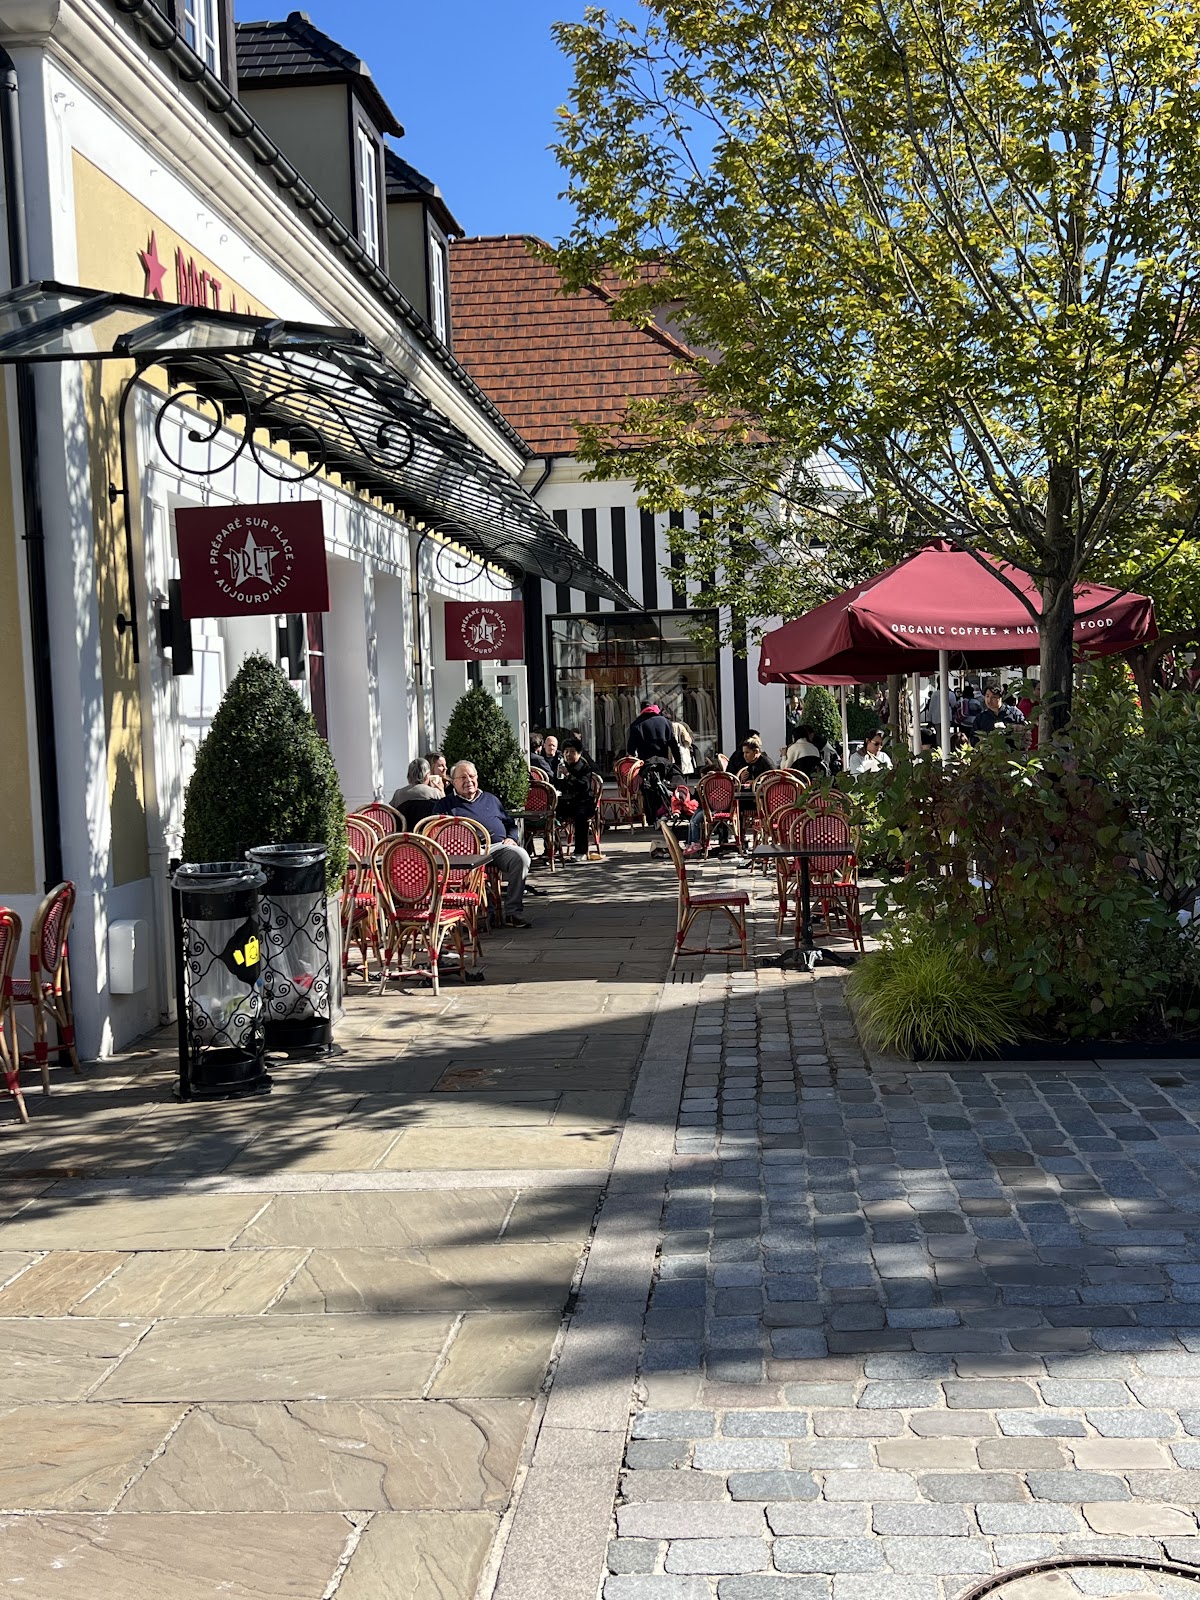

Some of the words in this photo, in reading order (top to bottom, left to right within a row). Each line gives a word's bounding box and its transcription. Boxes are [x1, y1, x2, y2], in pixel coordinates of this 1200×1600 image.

[210, 517, 243, 564] PRÉPARÉ
[245, 517, 269, 529] SUR
[270, 525, 294, 560] PLACE
[229, 546, 273, 579] PRET
[215, 575, 291, 604] AUJOURD'HUI
[481, 607, 494, 615] SUR
[494, 613, 506, 631] PLACE
[891, 623, 945, 635] ORGANIC
[950, 626, 997, 636] COFFEE
[1080, 618, 1114, 630] FOOD
[471, 623, 496, 640] PRET
[464, 639, 503, 653] AUJOURD'HUI
